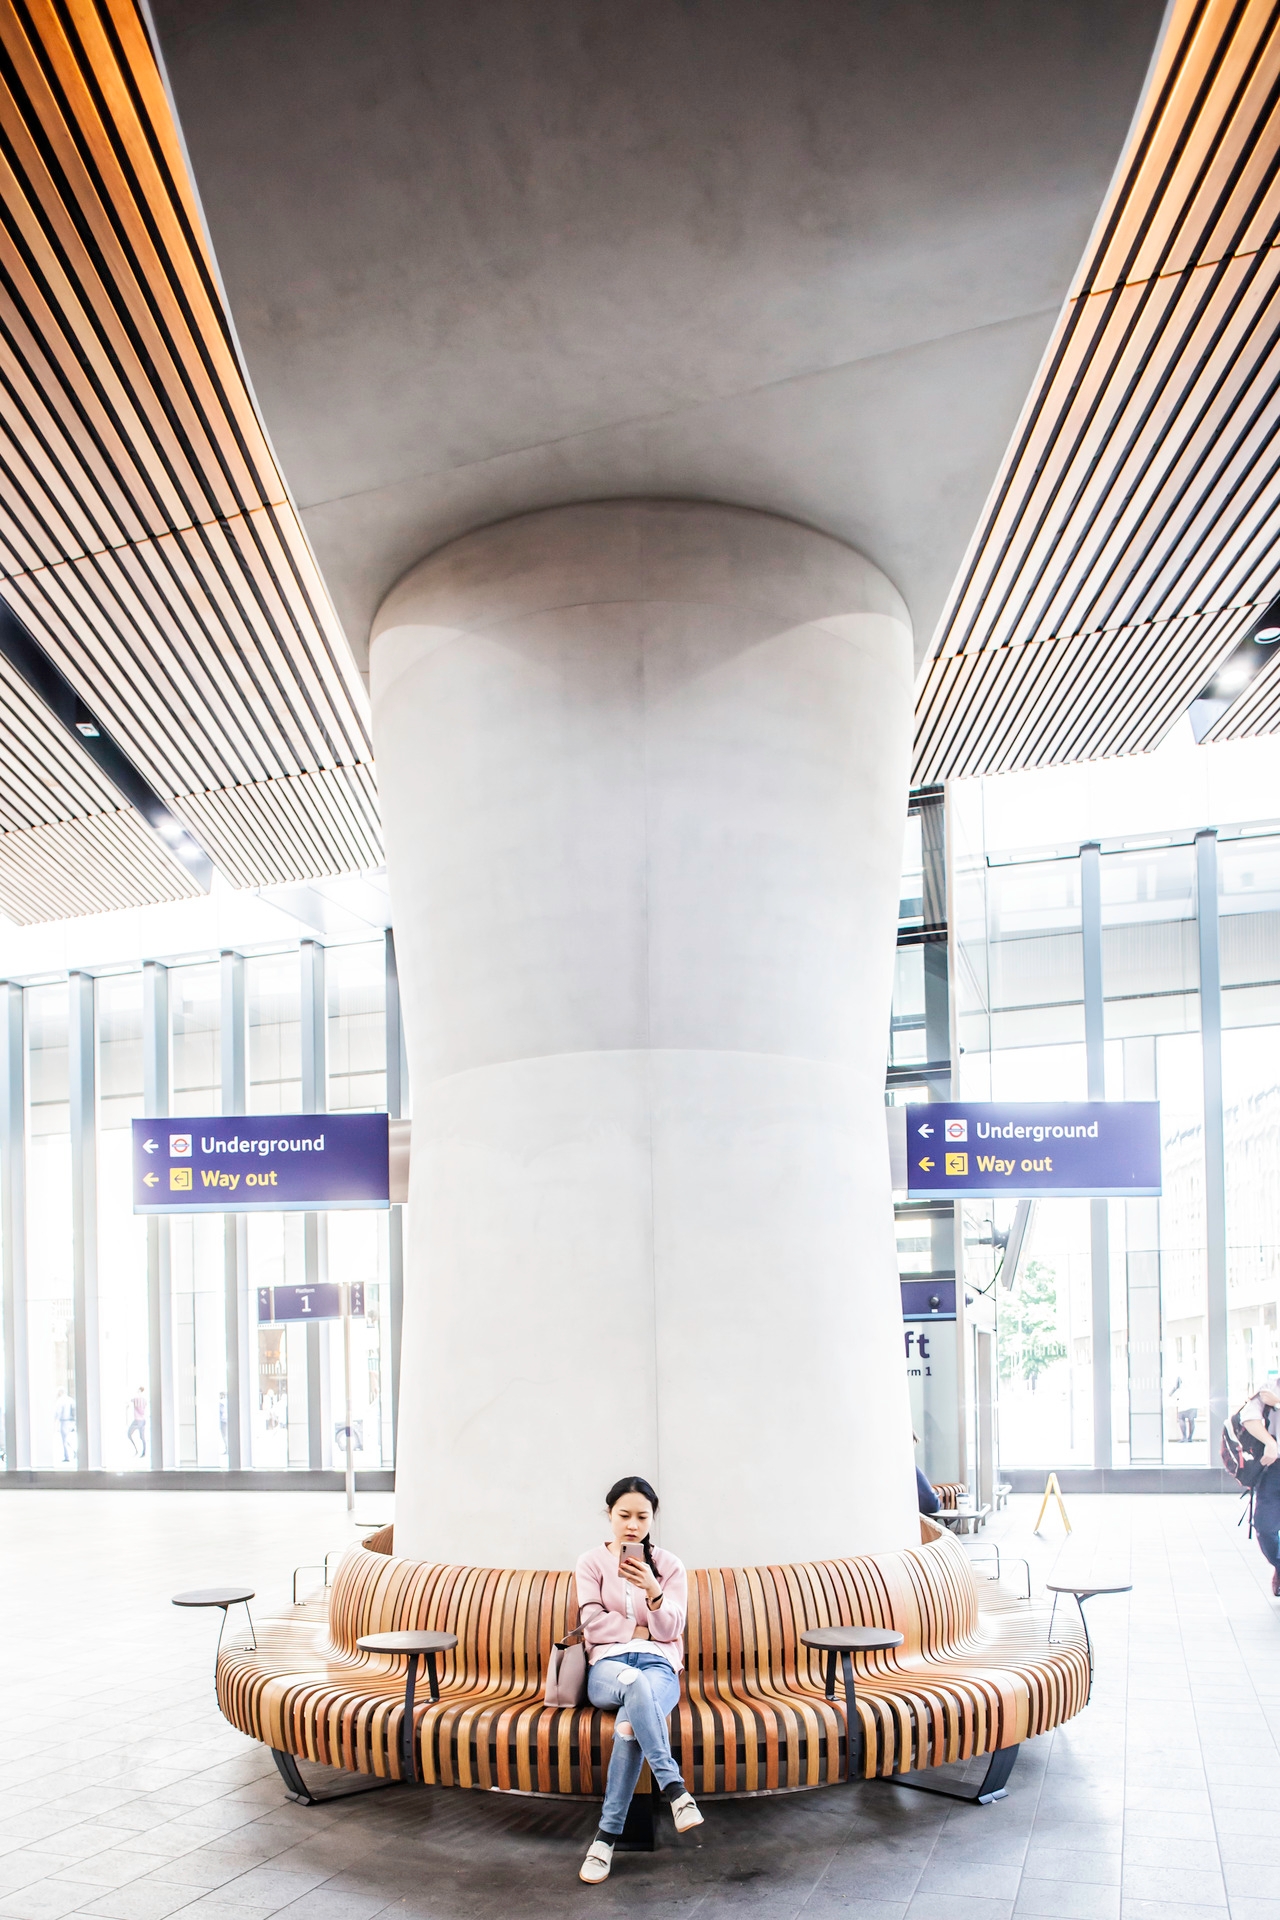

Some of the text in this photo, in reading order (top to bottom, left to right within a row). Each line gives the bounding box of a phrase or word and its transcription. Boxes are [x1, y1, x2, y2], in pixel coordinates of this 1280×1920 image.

[977, 1121, 1099, 1142] Underground
[201, 1134, 325, 1156] Underground
[976, 1156, 1053, 1175] Way out
[201, 1170, 278, 1190] Way out
[301, 1295, 312, 1313] 1
[904, 1331, 930, 1358] ft
[925, 1366, 932, 1376] 1
